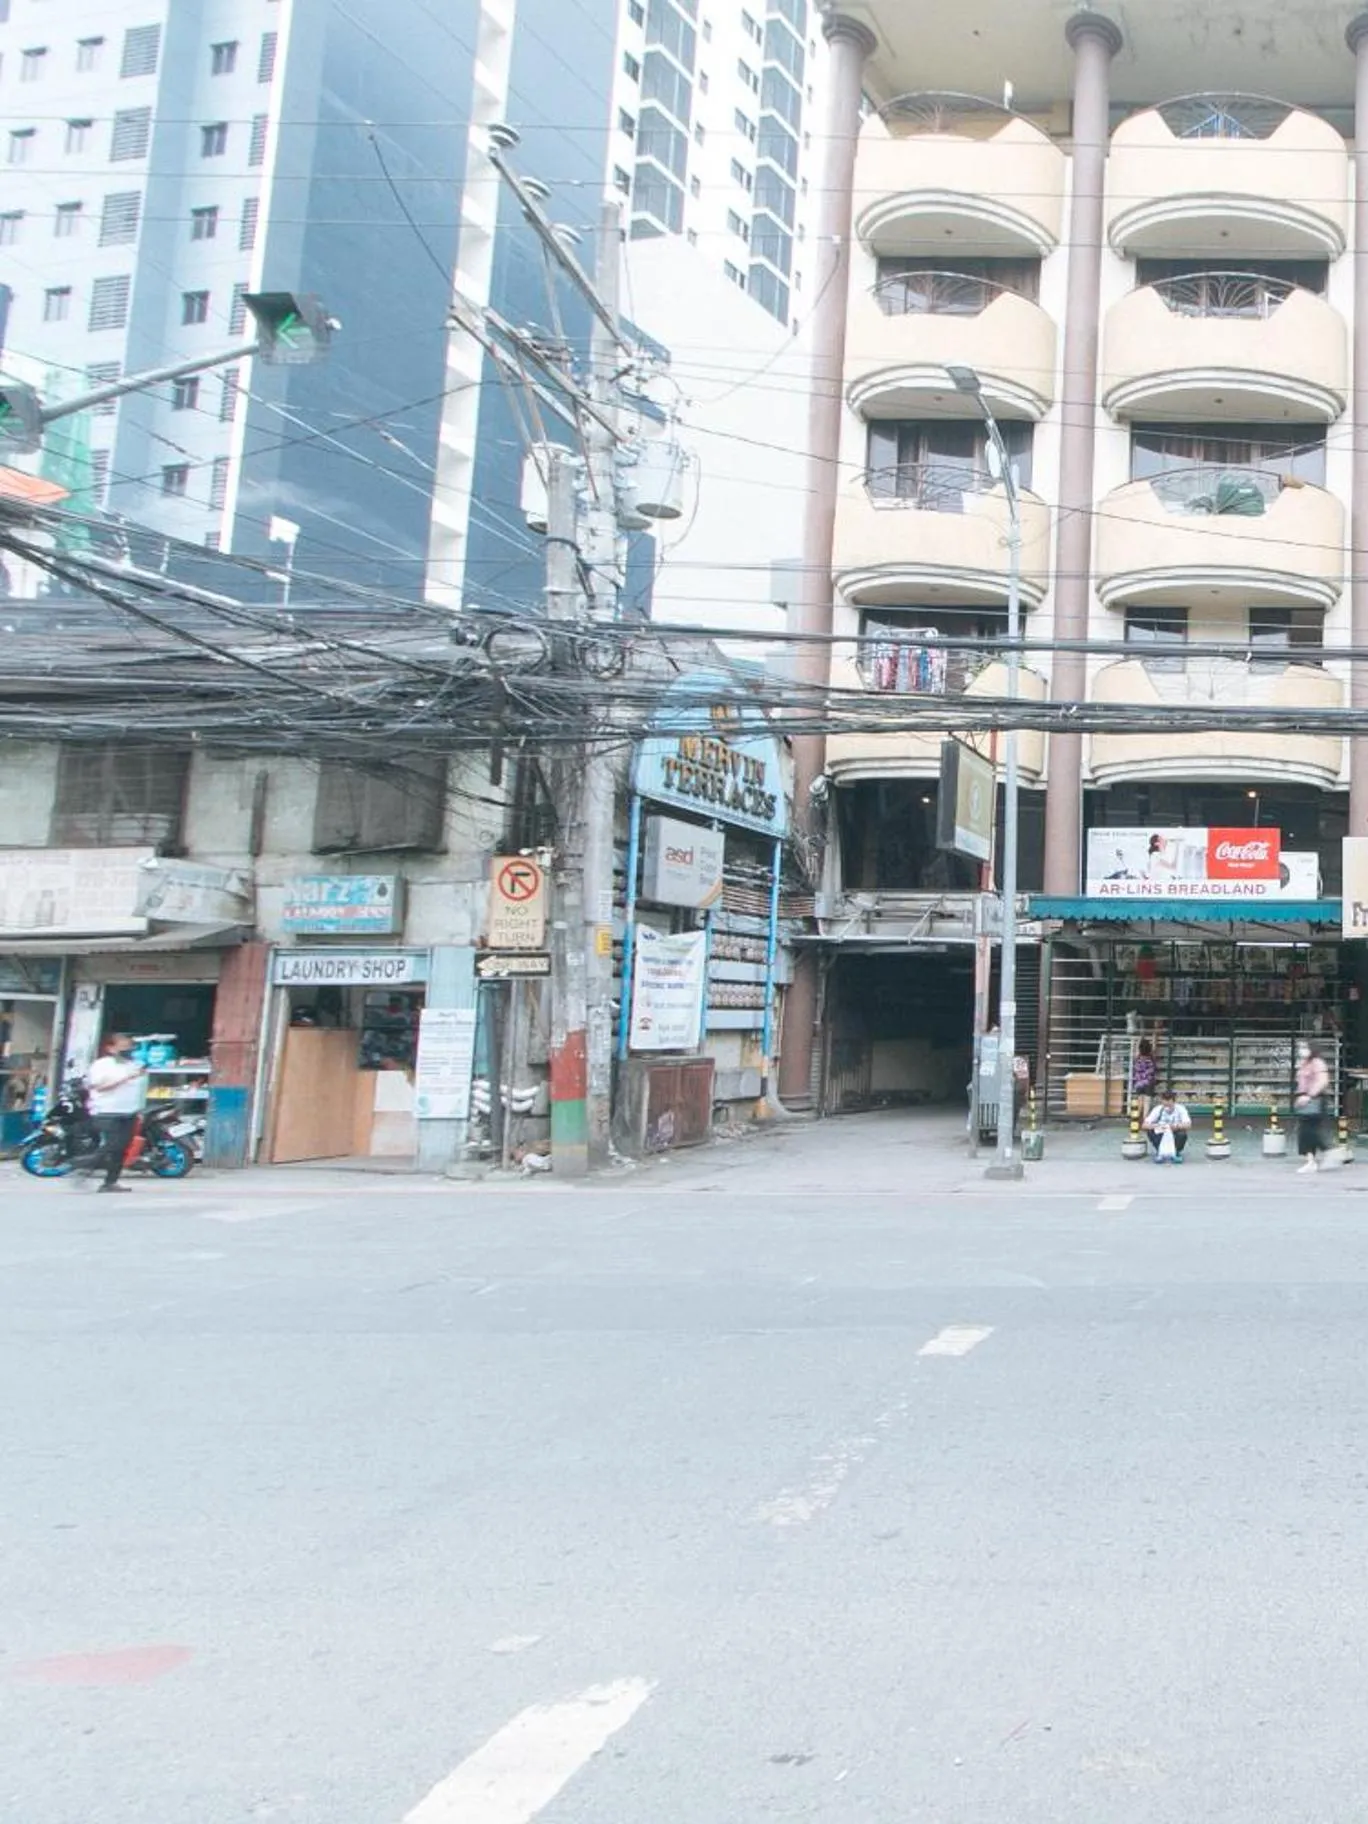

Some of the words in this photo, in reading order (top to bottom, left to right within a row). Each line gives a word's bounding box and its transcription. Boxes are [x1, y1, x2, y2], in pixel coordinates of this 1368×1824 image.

[661, 756, 777, 821] TERRACES
[1099, 883, 1163, 896] AR-LINS
[1167, 883, 1268, 896] BREADLAND
[504, 904, 529, 917] NO
[493, 918, 540, 930] RIGHT
[498, 931, 536, 943] TURN
[281, 960, 354, 980] LAUNDRY
[361, 960, 407, 978] SHOP
